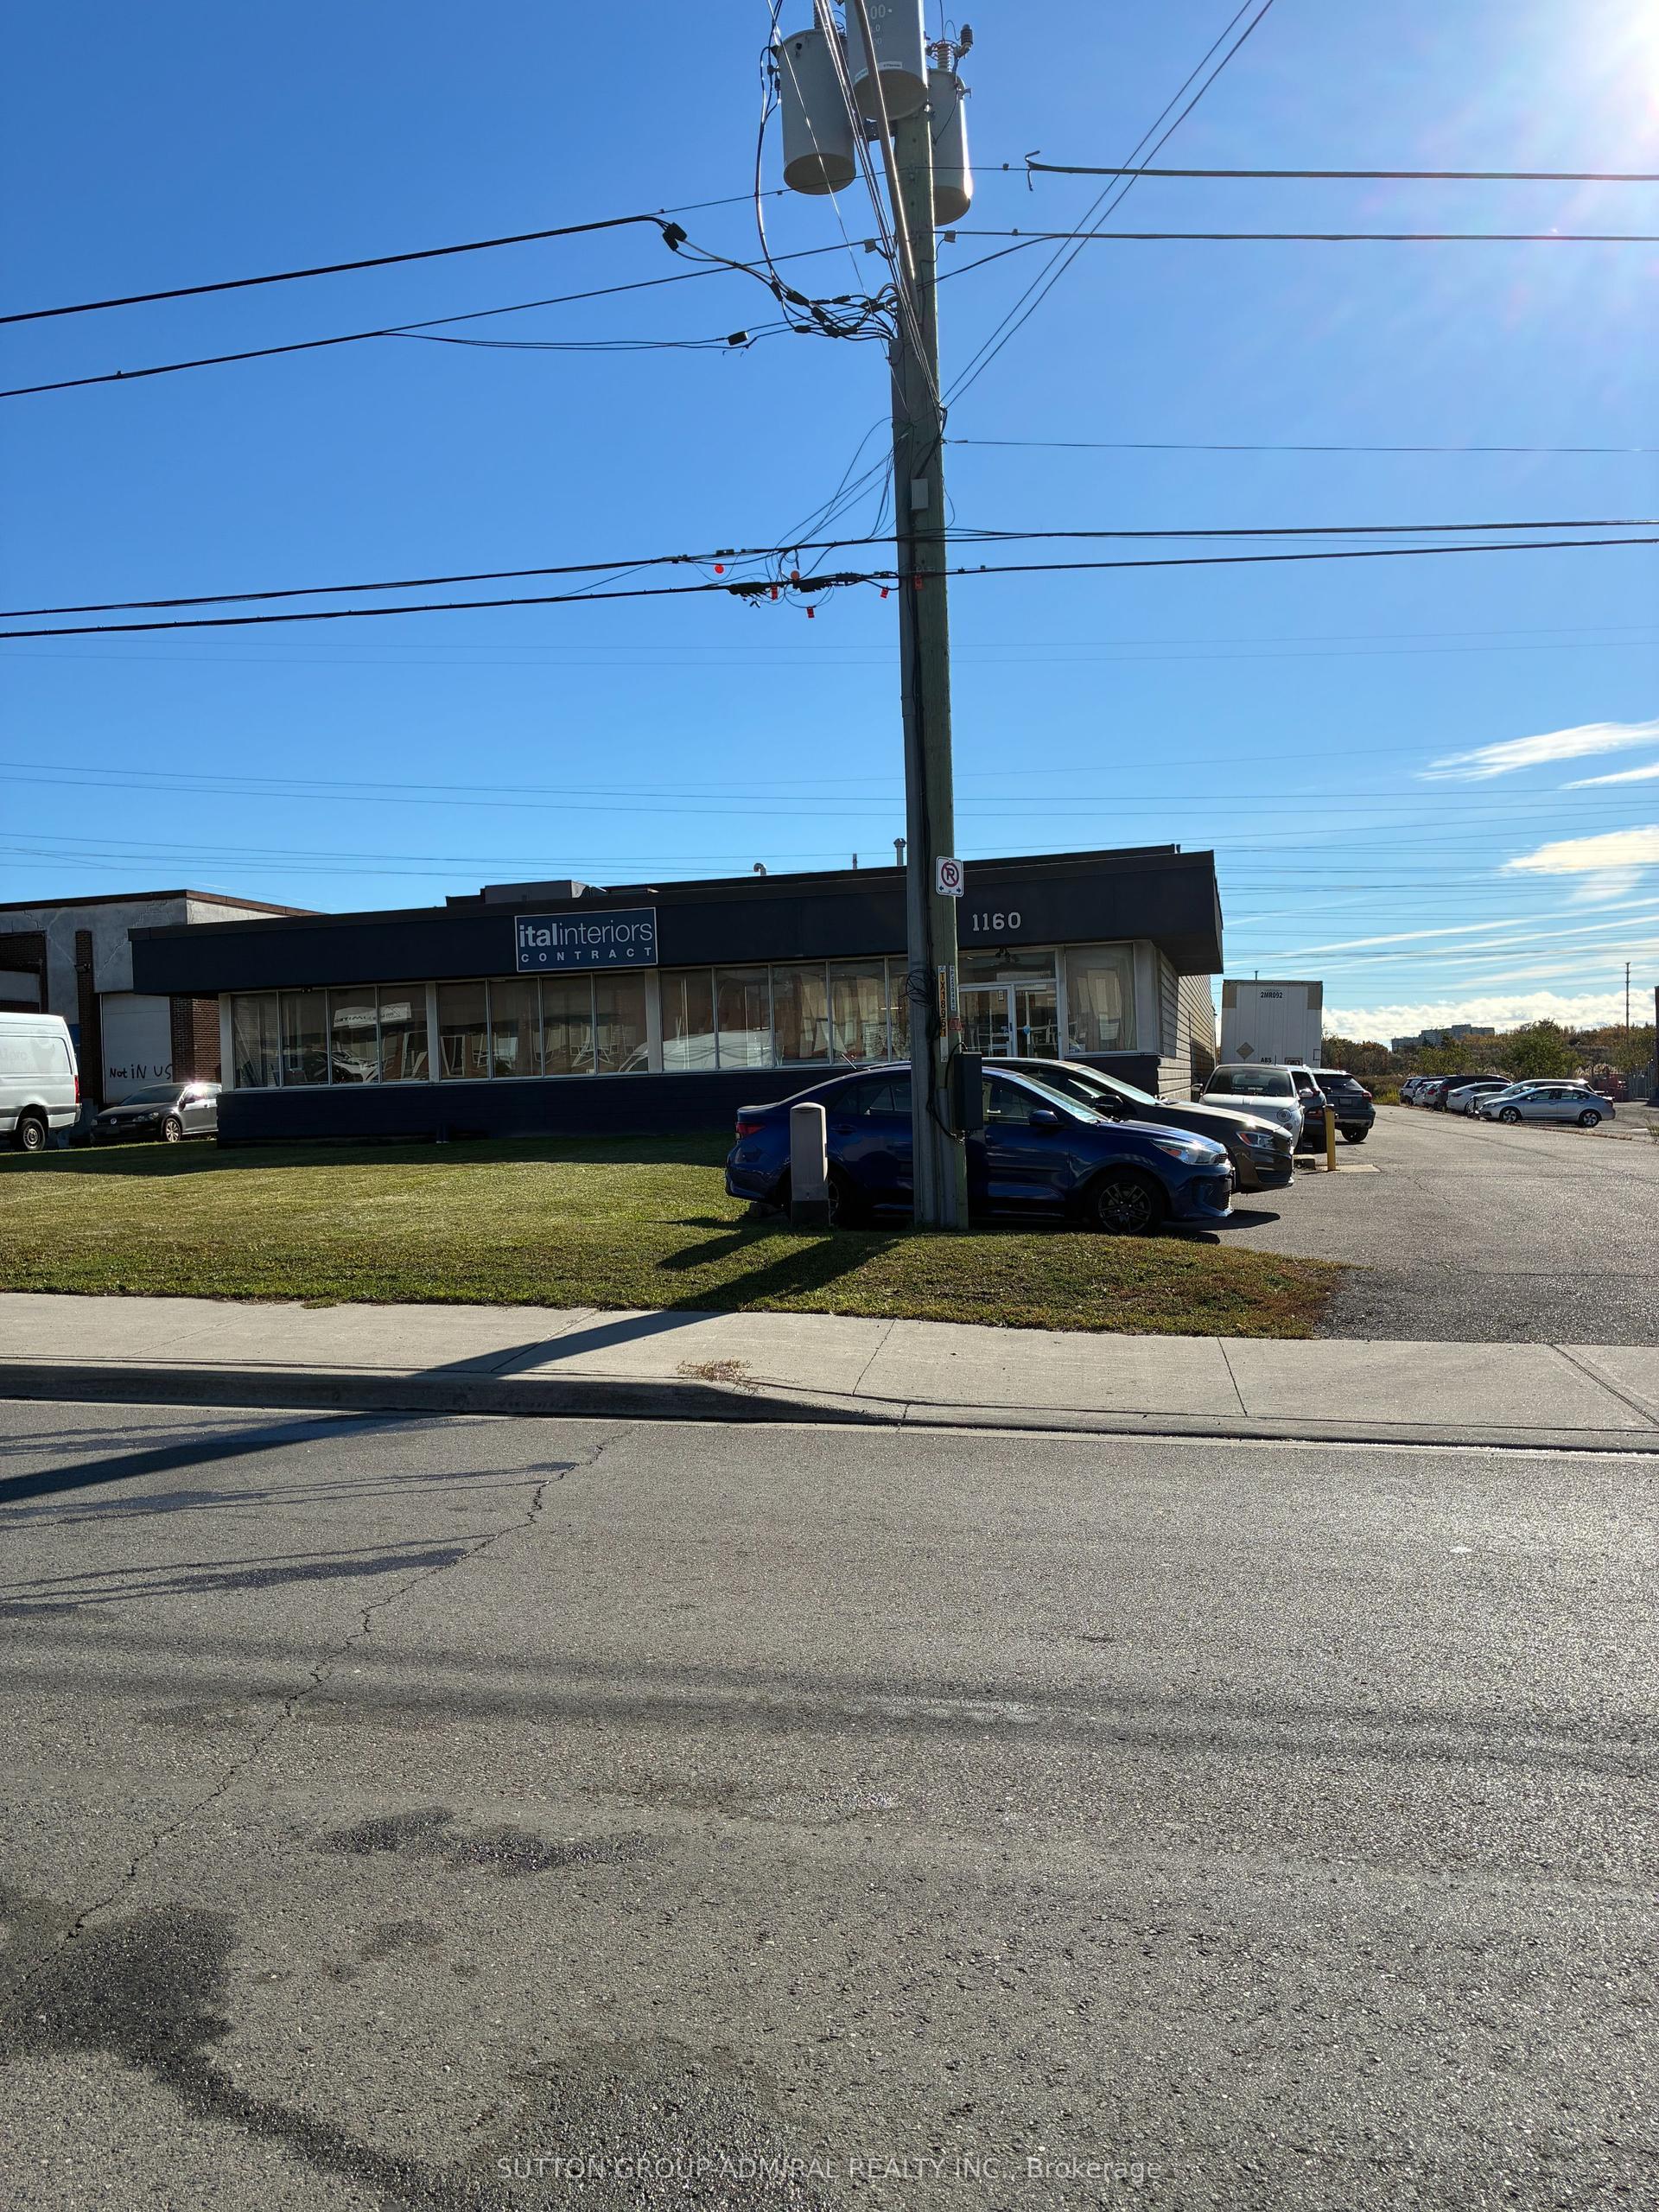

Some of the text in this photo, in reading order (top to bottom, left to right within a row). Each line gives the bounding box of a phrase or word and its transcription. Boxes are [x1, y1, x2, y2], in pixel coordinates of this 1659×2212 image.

[972, 912, 1021, 931] 1160
[519, 919, 653, 948] italinteriors
[521, 947, 652, 963] CONTRACT
[110, 1067, 128, 1078] Not
